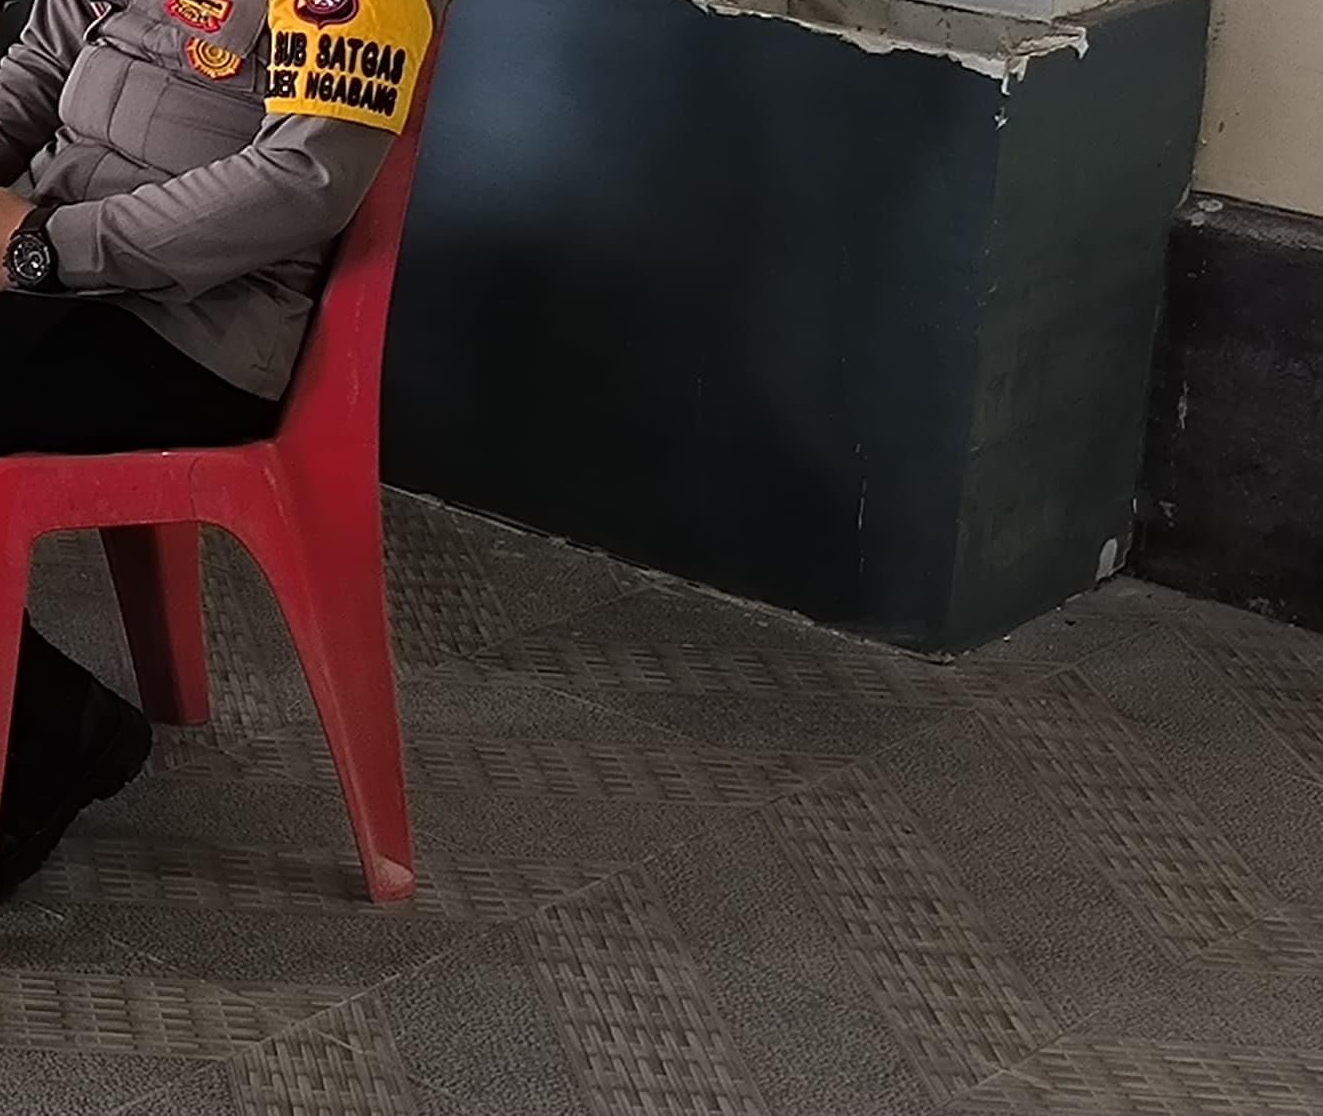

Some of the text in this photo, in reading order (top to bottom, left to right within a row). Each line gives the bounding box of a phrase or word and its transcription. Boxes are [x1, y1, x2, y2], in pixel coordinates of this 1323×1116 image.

[274, 30, 406, 85] SUB SATGAS
[304, 71, 398, 117] NGABANG
